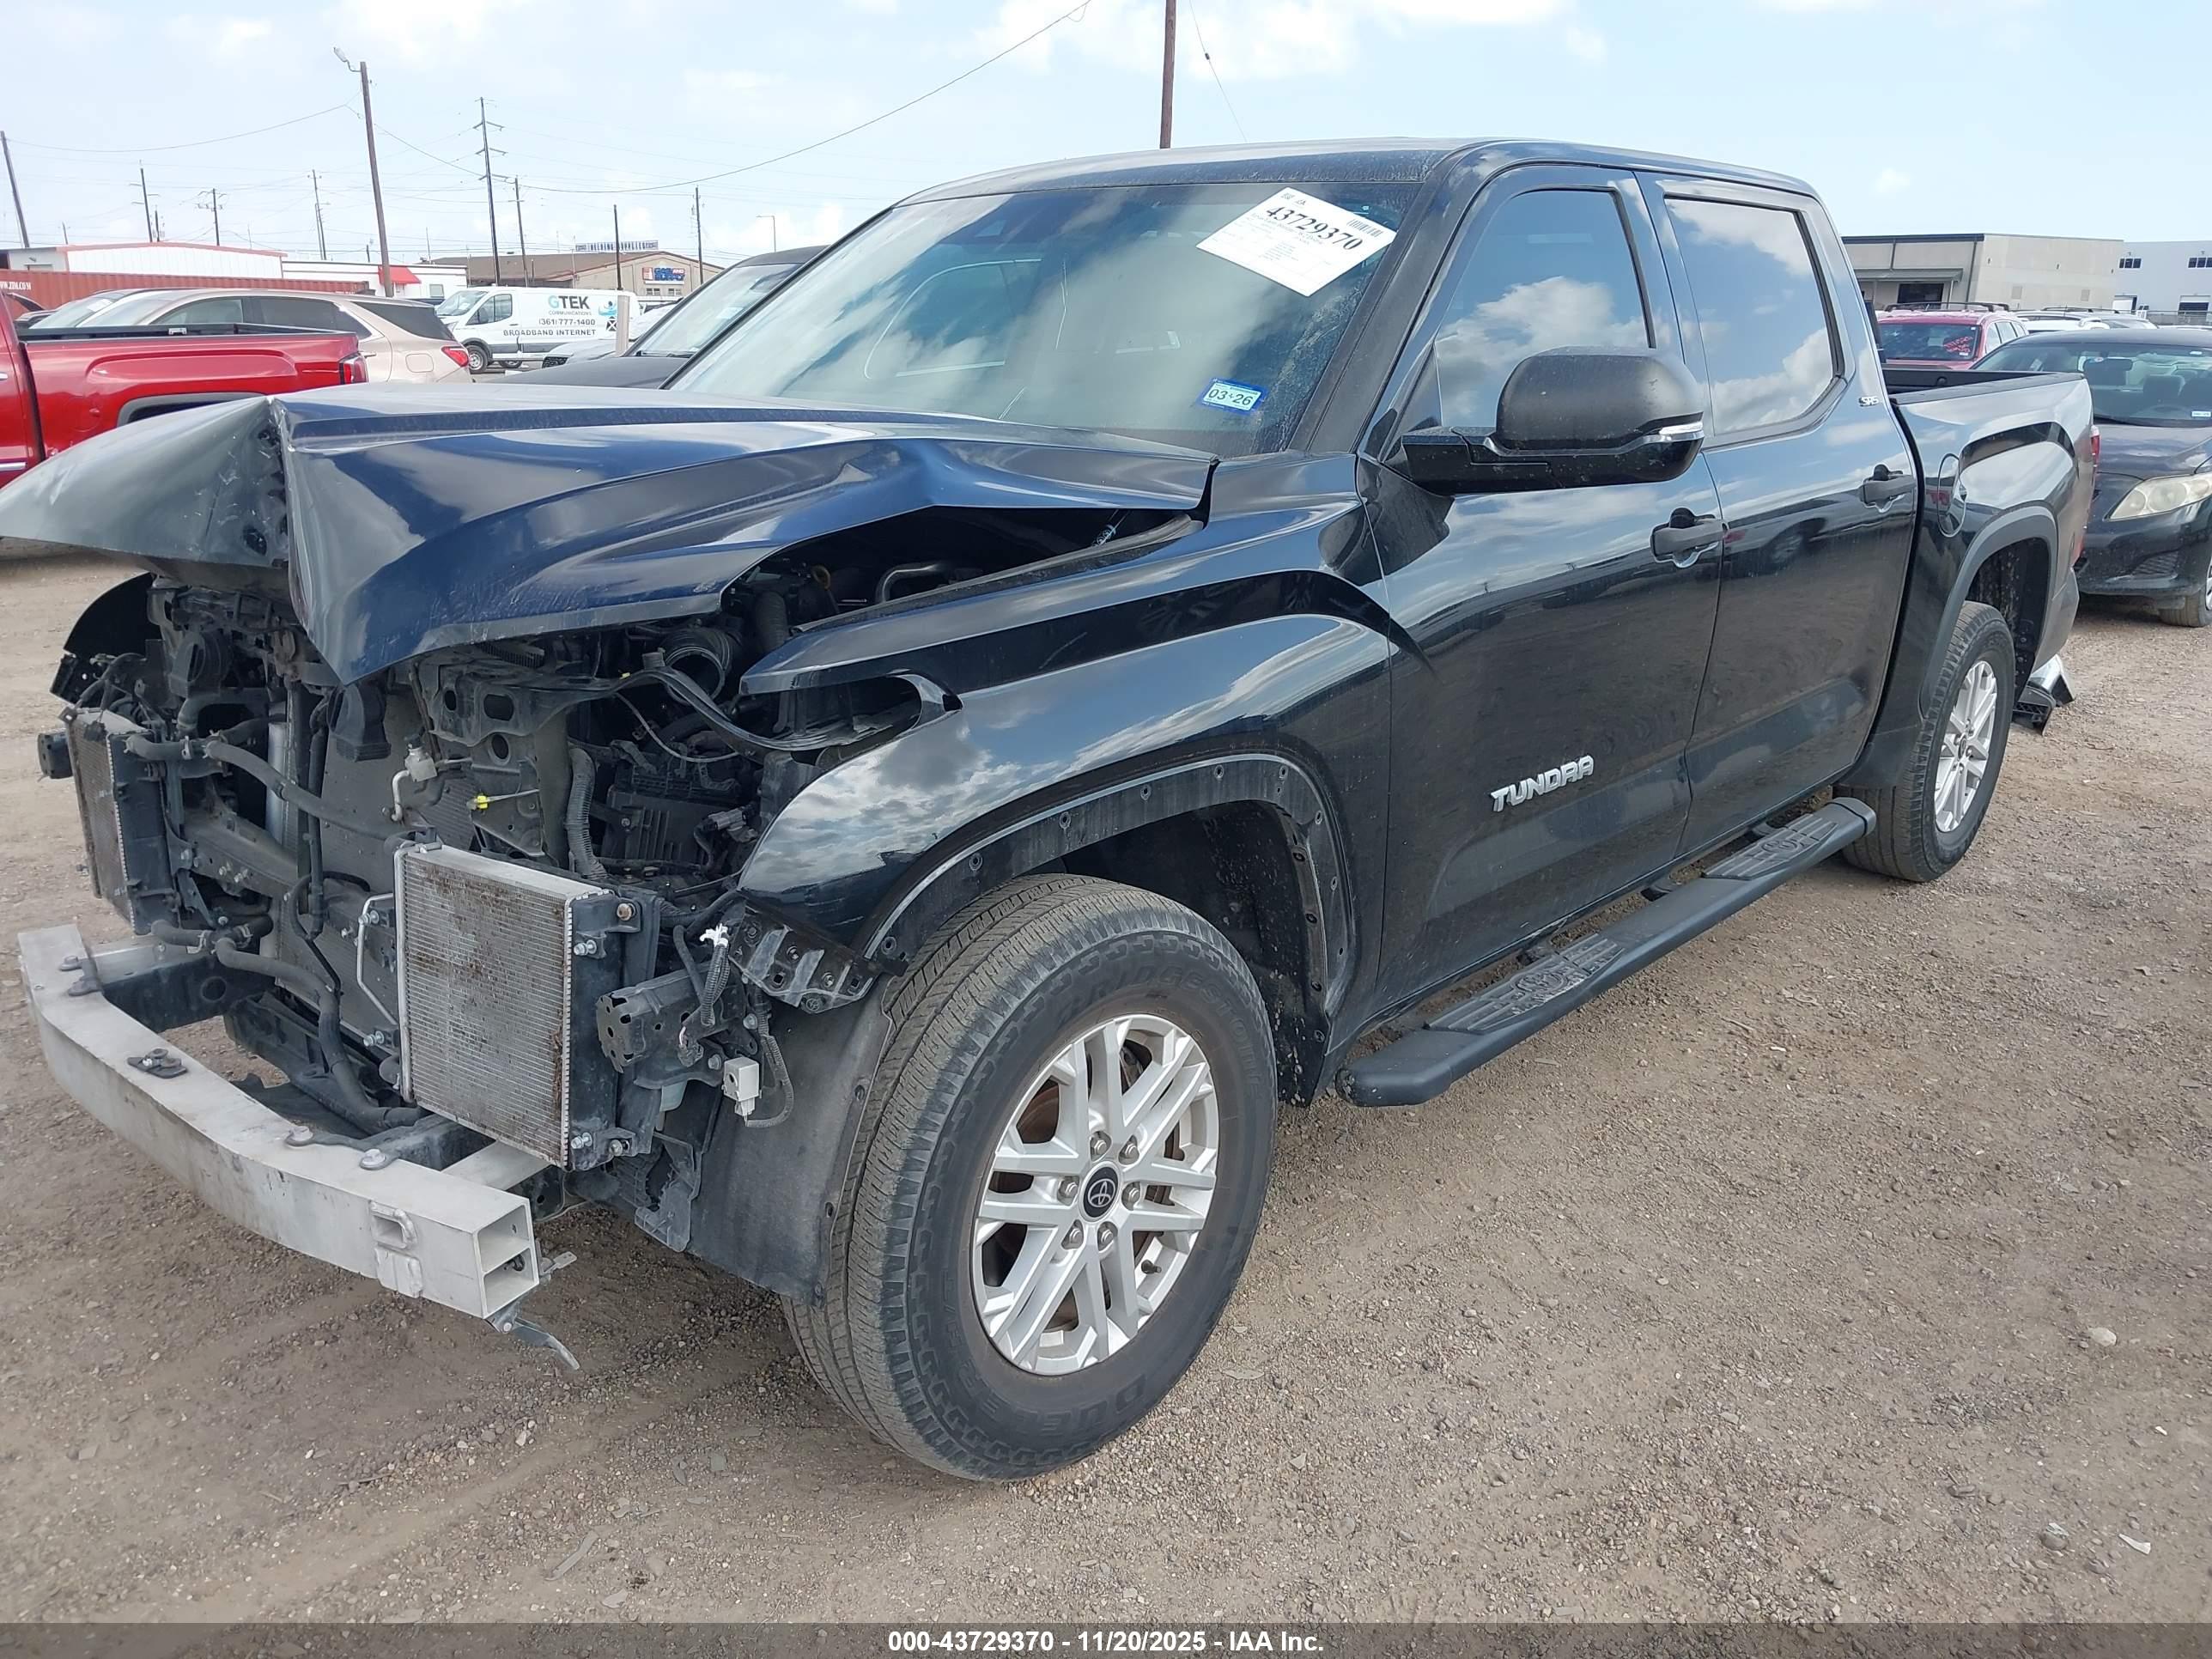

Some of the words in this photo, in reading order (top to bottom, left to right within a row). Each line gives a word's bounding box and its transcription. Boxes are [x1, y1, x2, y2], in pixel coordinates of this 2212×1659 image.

[1267, 207, 1364, 251] 43729370
[548, 295, 590, 309] GTEK
[1491, 755, 1594, 812] TUNDRA
